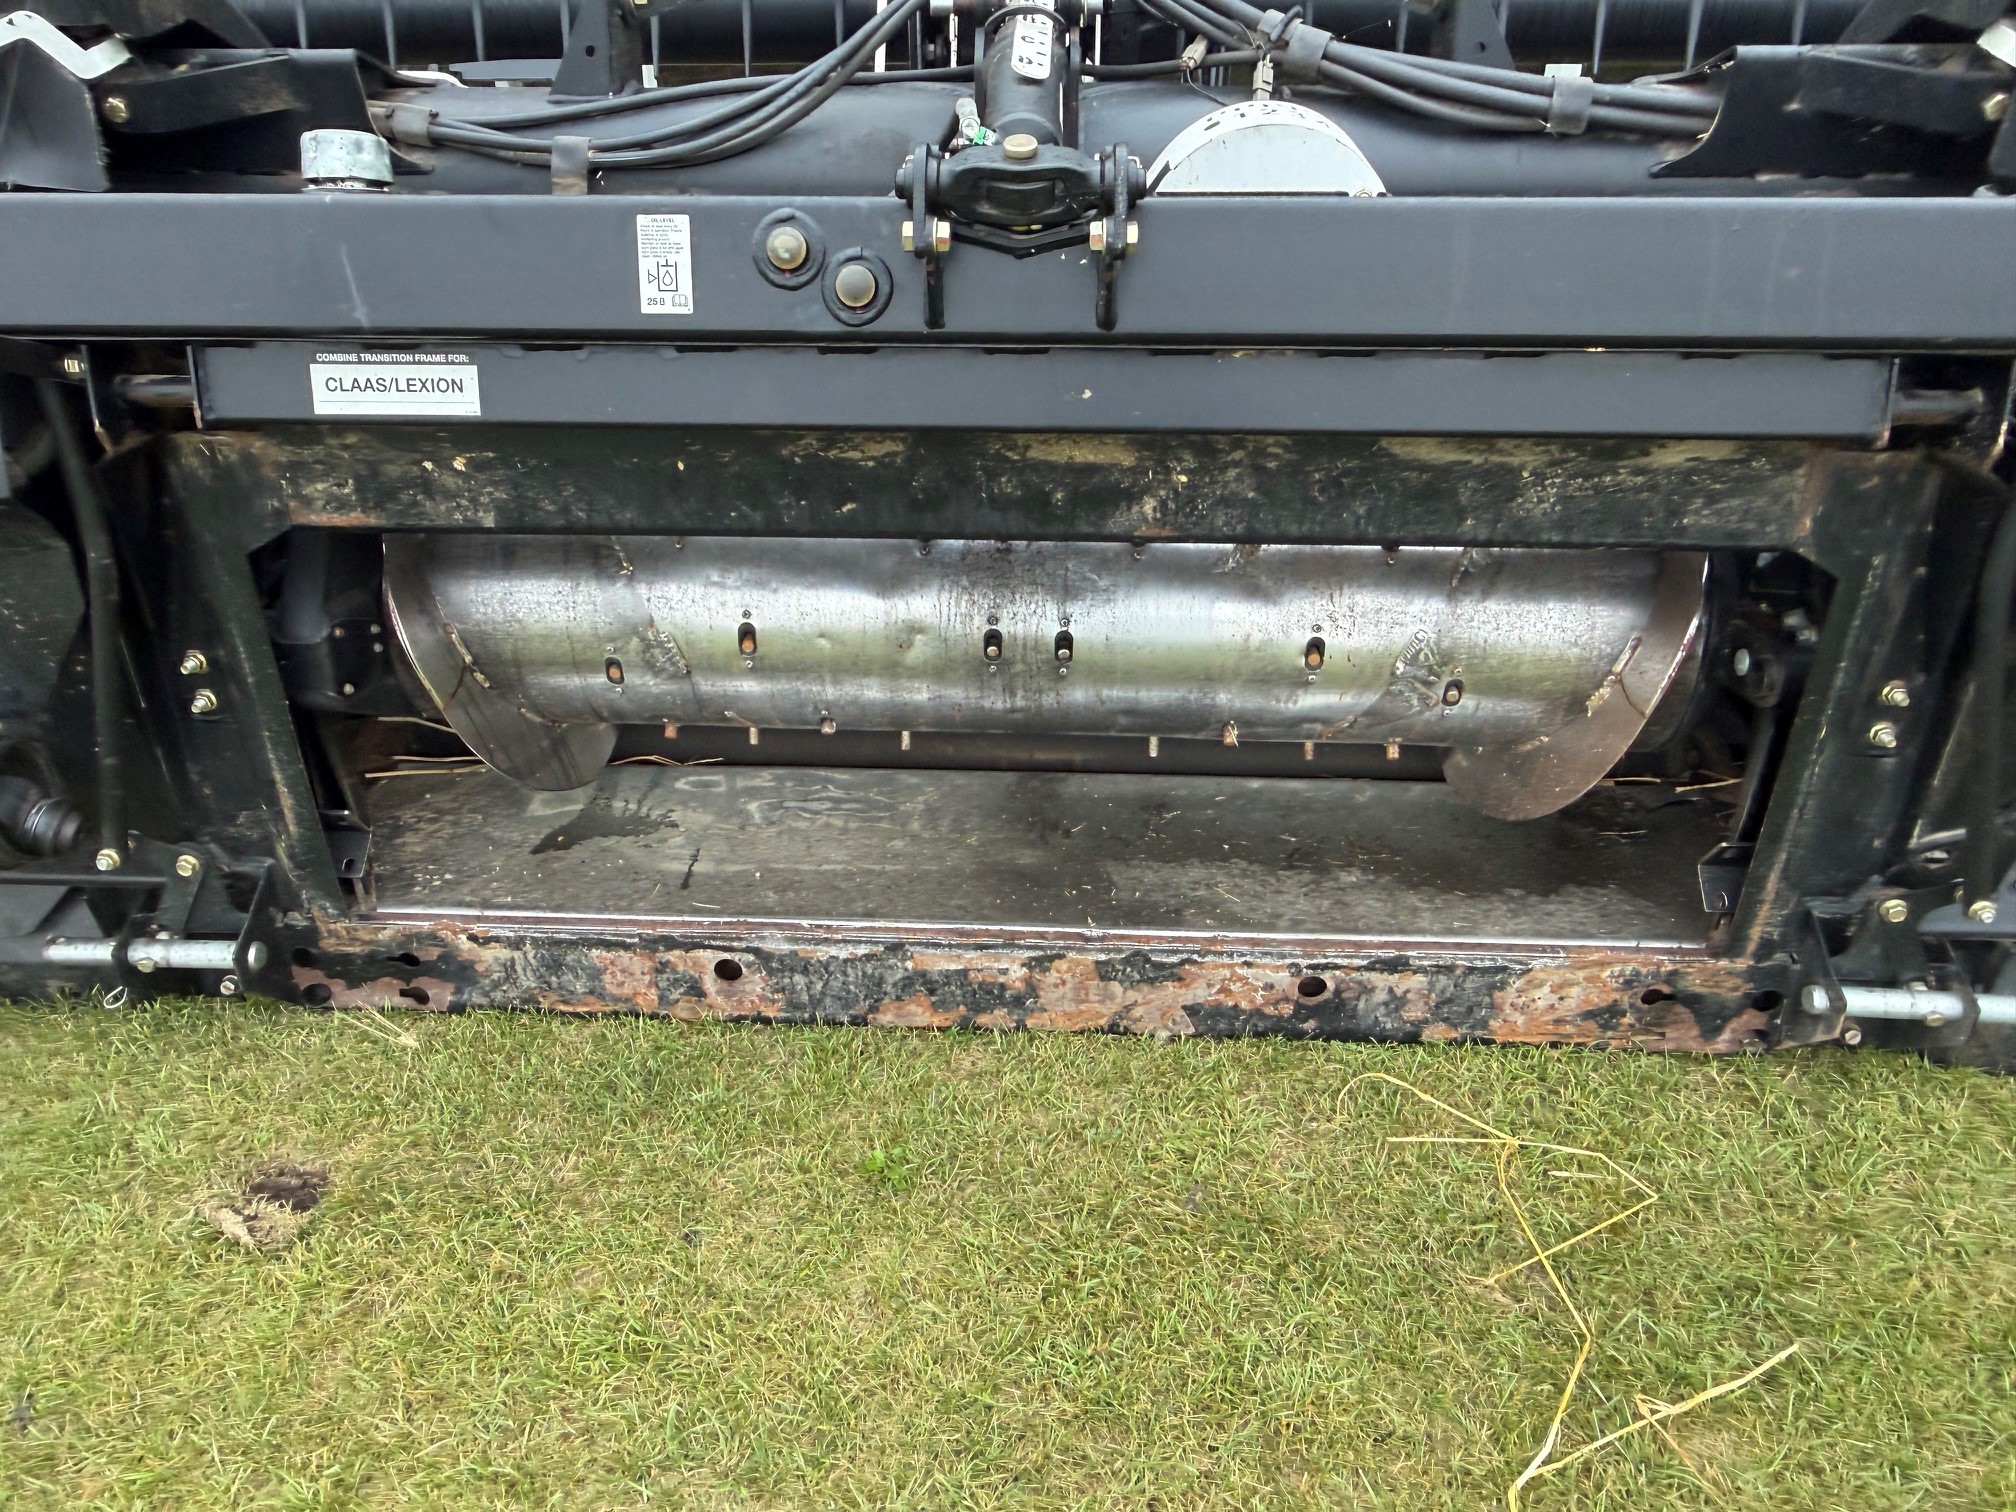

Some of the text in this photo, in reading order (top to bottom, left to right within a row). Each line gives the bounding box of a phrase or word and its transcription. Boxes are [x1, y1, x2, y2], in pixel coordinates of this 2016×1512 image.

[647, 297, 658, 306] 25
[316, 353, 469, 363] COMBINE TRANSITION FRAME FOR:
[325, 377, 464, 393] CLAAS/LEXION
